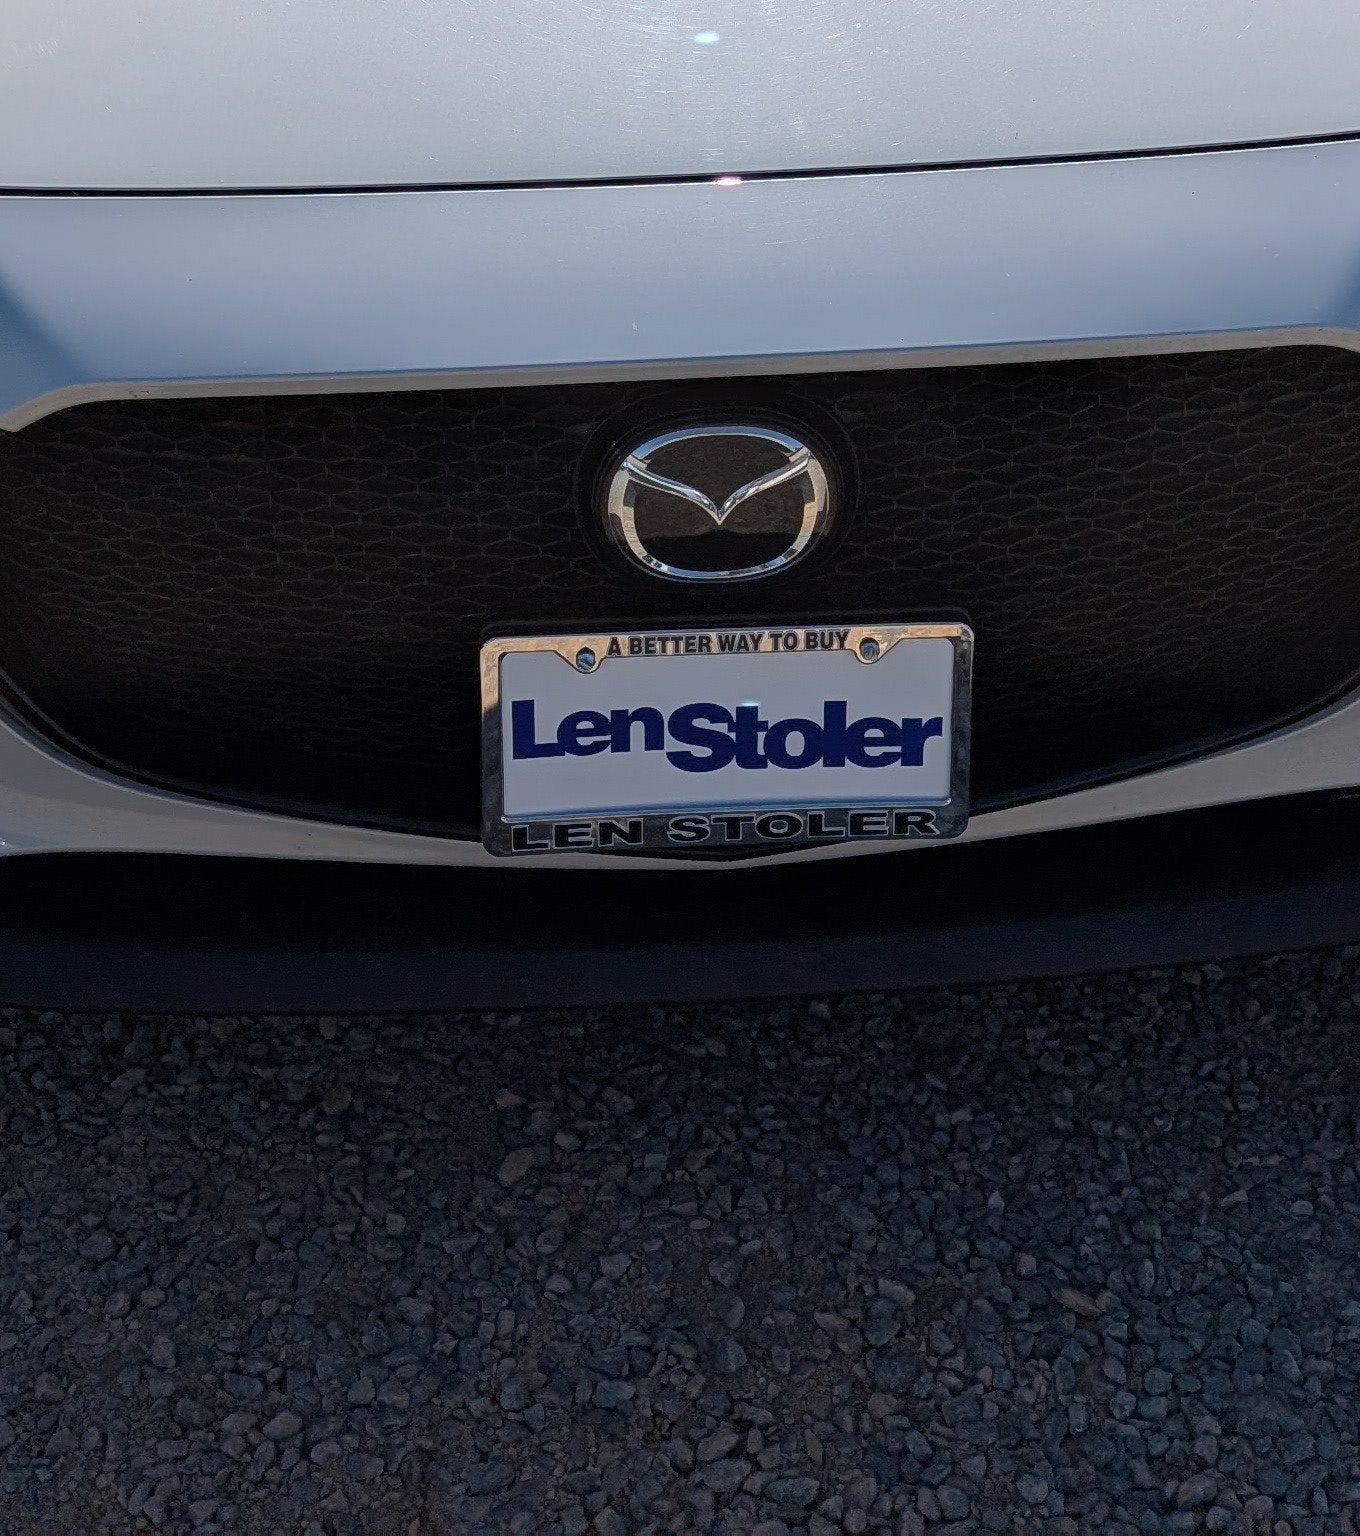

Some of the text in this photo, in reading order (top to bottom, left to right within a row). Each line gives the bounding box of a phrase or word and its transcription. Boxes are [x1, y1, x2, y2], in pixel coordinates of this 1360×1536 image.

[607, 629, 850, 656] A BETTER WAY TO BUY
[511, 809, 941, 852] LEN STOLER
